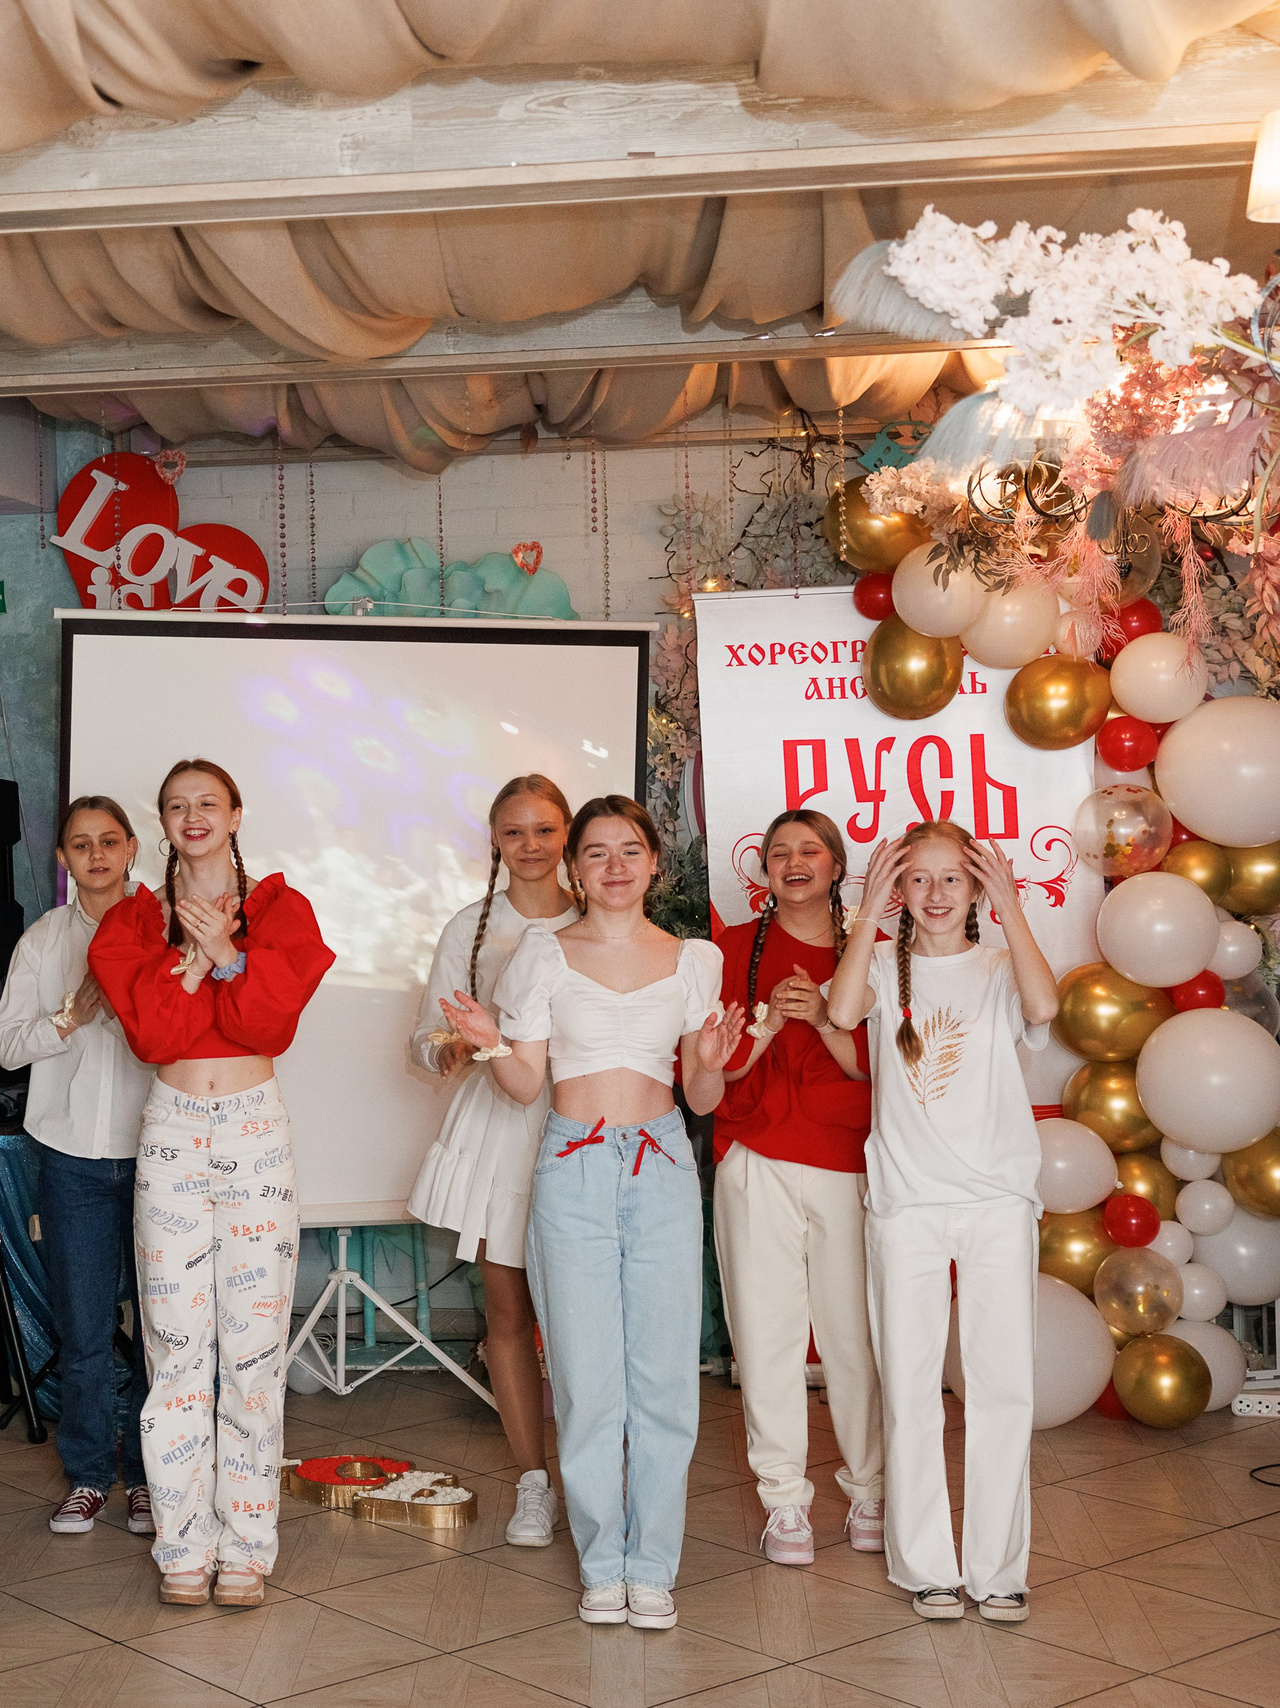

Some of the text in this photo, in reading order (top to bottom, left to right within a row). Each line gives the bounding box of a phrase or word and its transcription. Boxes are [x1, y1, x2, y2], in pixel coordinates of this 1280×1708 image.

[49, 469, 264, 612] Love
[724, 639, 869, 667] ХОРЕОГР
[783, 734, 1019, 843] РУСЬ
